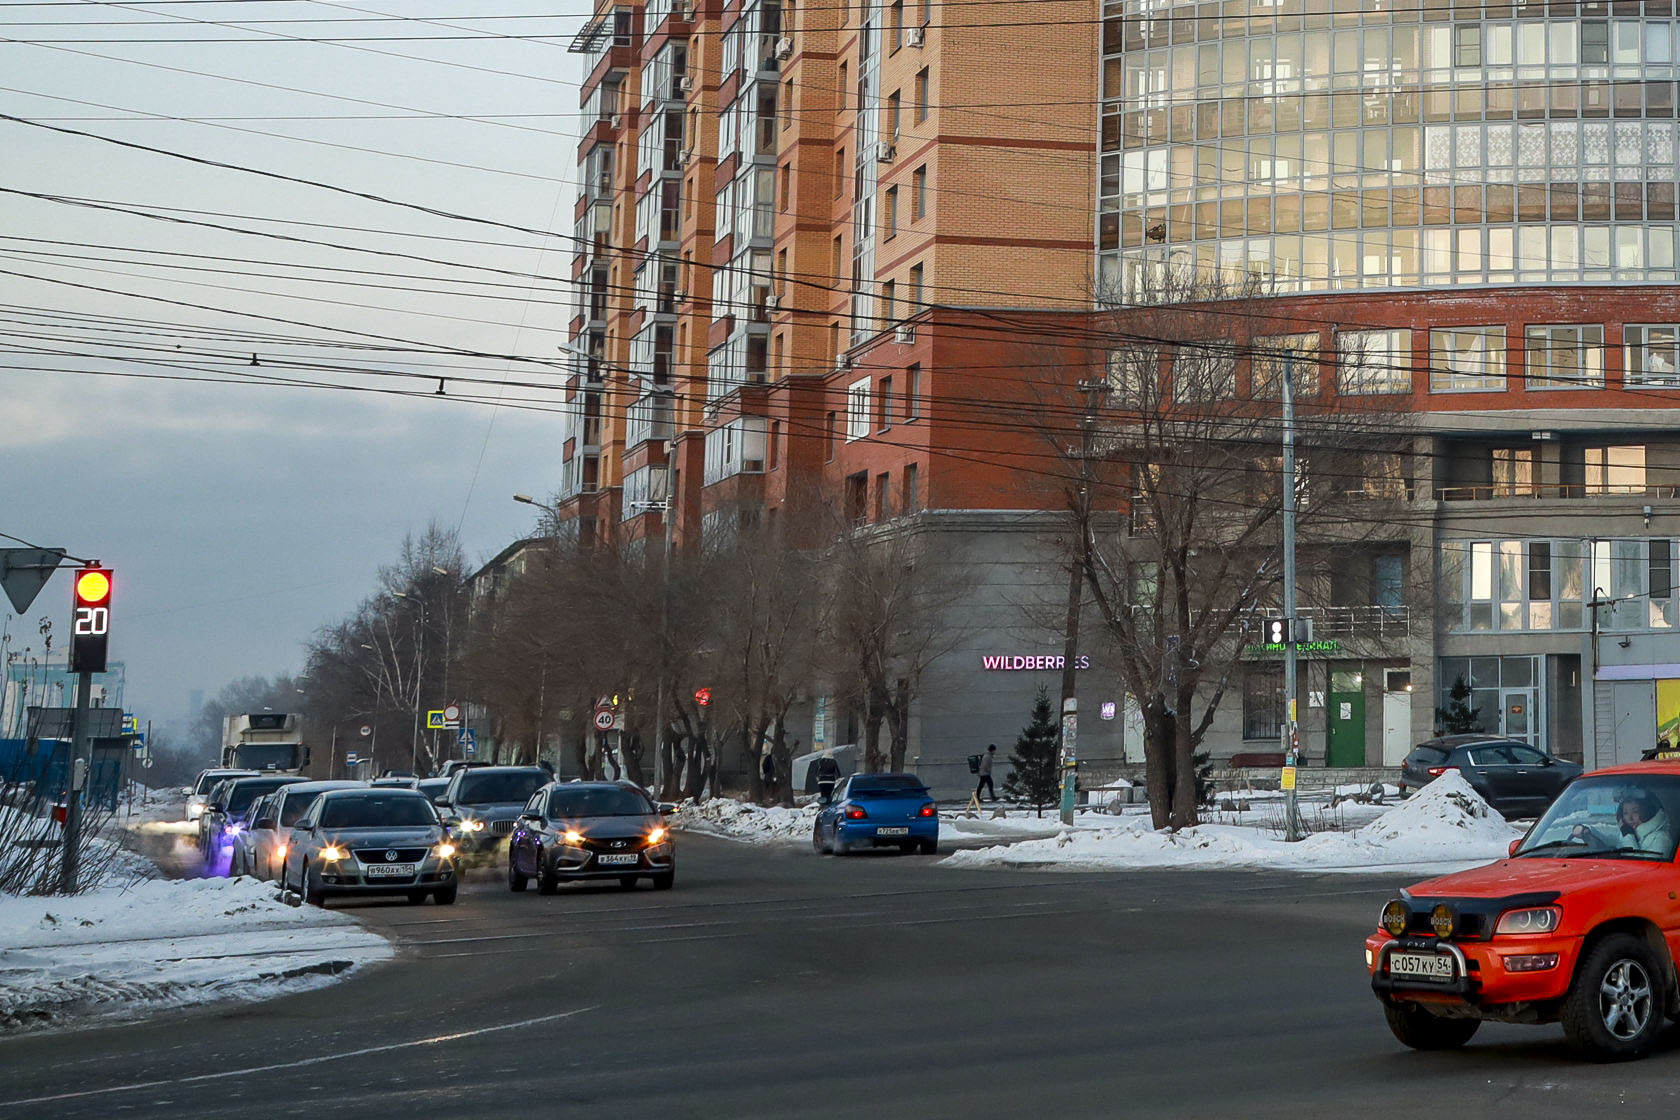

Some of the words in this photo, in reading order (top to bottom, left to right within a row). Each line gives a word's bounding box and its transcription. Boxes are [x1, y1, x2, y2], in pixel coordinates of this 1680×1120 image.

[75, 608, 108, 634] 20
[983, 655, 1089, 669] WILDBERRS
[598, 716, 611, 724] 40
